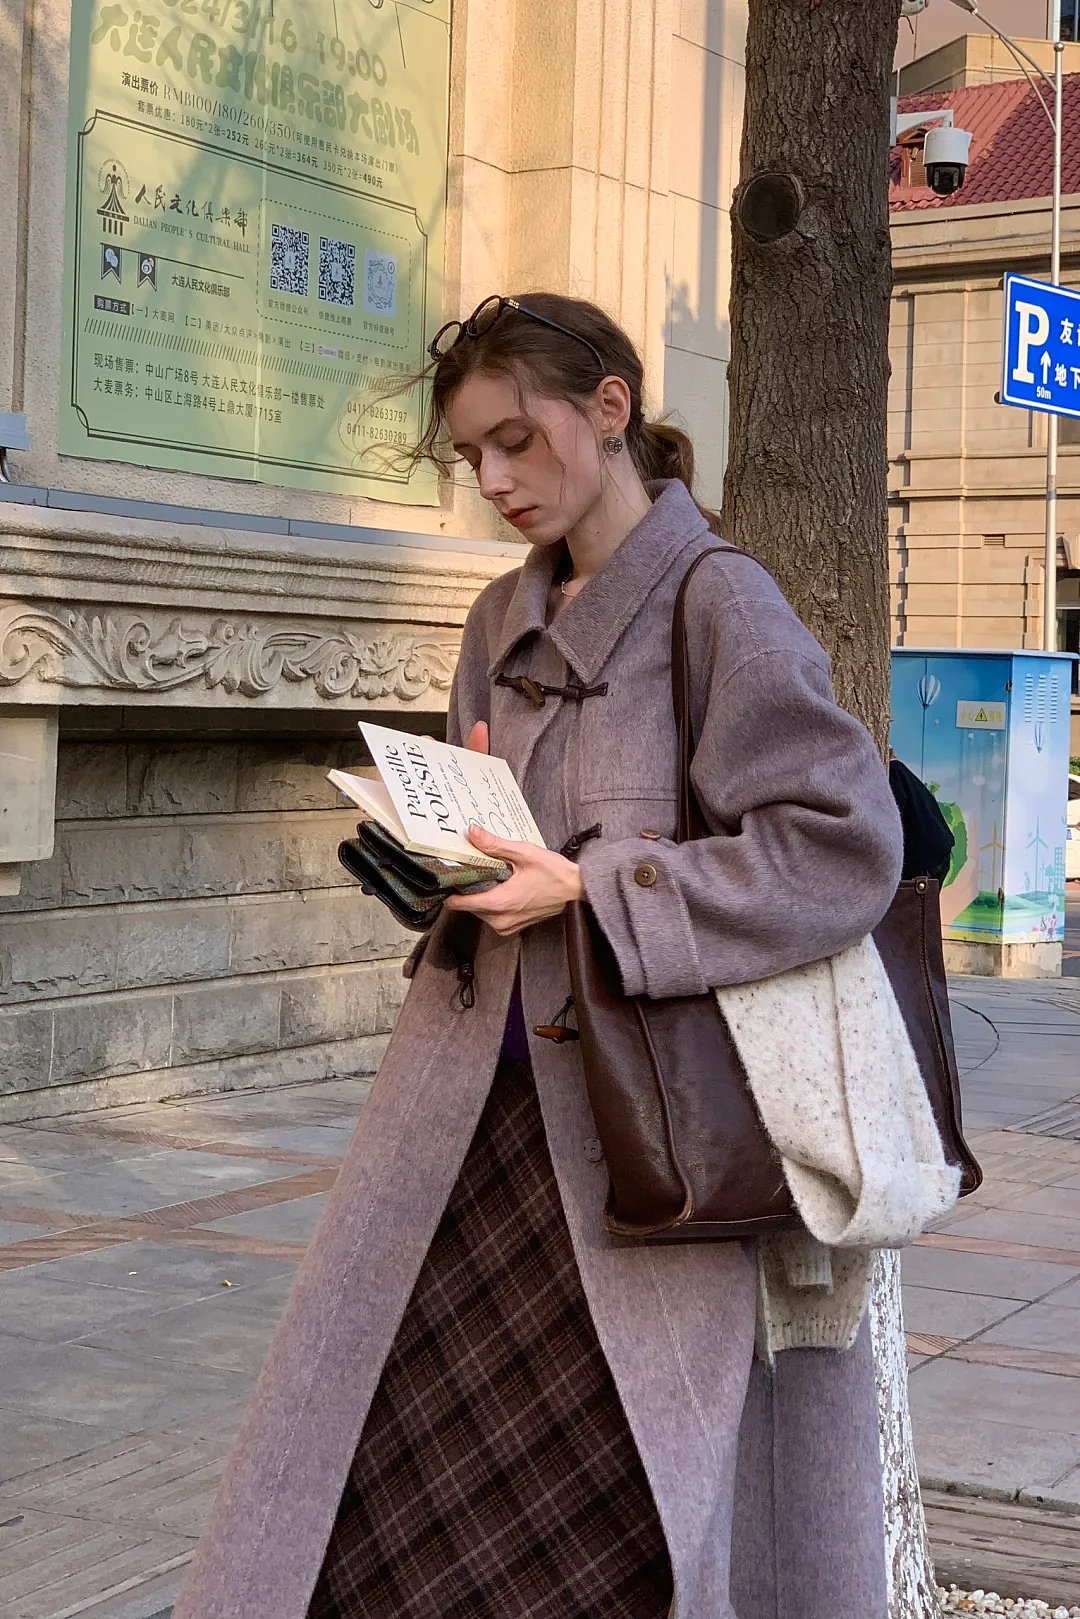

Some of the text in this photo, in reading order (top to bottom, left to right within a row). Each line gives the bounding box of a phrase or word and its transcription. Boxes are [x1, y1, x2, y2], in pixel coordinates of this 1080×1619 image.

[316, 31, 387, 87] 19:00
[121, 71, 159, 97] 演出票价
[133, 215, 157, 230] DALIAN
[196, 231, 230, 249] CULTURAL
[233, 239, 250, 254] HALL
[171, 273, 231, 298] 大连人民文化俱乐部
[1012, 300, 1050, 384] P
[1060, 318, 1080, 347] 友
[1055, 363, 1080, 390] 地下
[93, 376, 282, 424] 大麦票务：中山区上海路4号上鼎大厦715室
[1036, 386, 1052, 400] 50m
[347, 401, 408, 423] 0411-82633797
[346, 422, 408, 444] 0411-82630289
[385, 745, 428, 820] Pareille
[402, 742, 459, 836] POÉSIE
